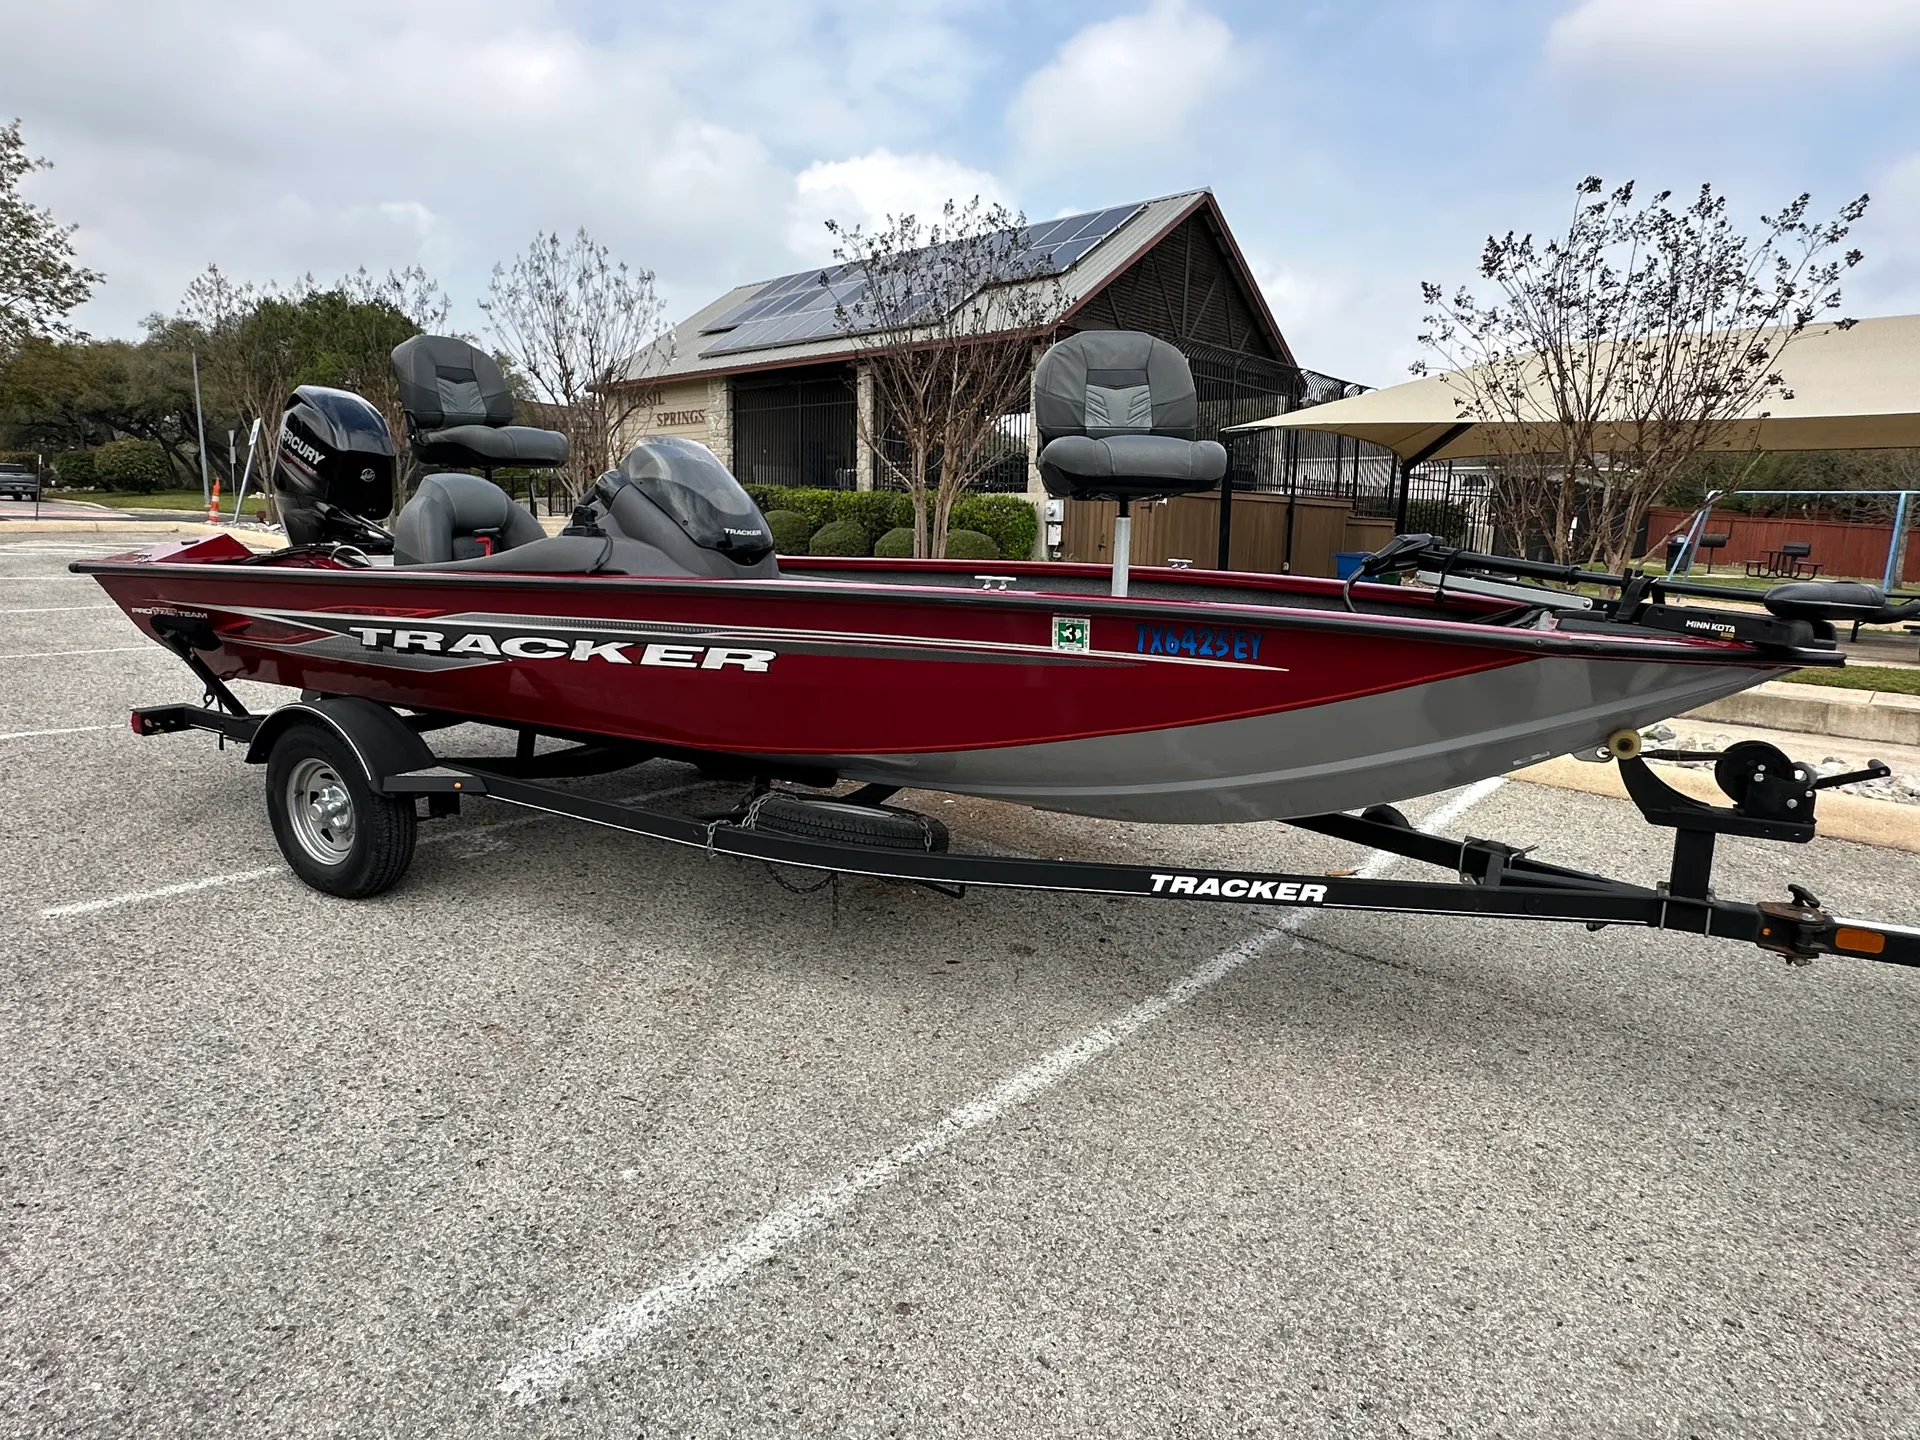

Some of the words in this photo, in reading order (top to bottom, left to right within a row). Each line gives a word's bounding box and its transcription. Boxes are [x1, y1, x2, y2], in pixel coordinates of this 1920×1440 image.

[657, 408, 706, 427] SPRINGS
[282, 428, 326, 465] ERCURY
[723, 527, 762, 536] TRACKER
[131, 607, 153, 615] PRO
[178, 611, 208, 619] TEAM
[1065, 624, 1077, 643] 3
[1685, 620, 1711, 630] MINN
[1711, 623, 1736, 633] KOTA
[348, 626, 777, 673] TRACKER
[1150, 874, 1328, 903] TRACKER
